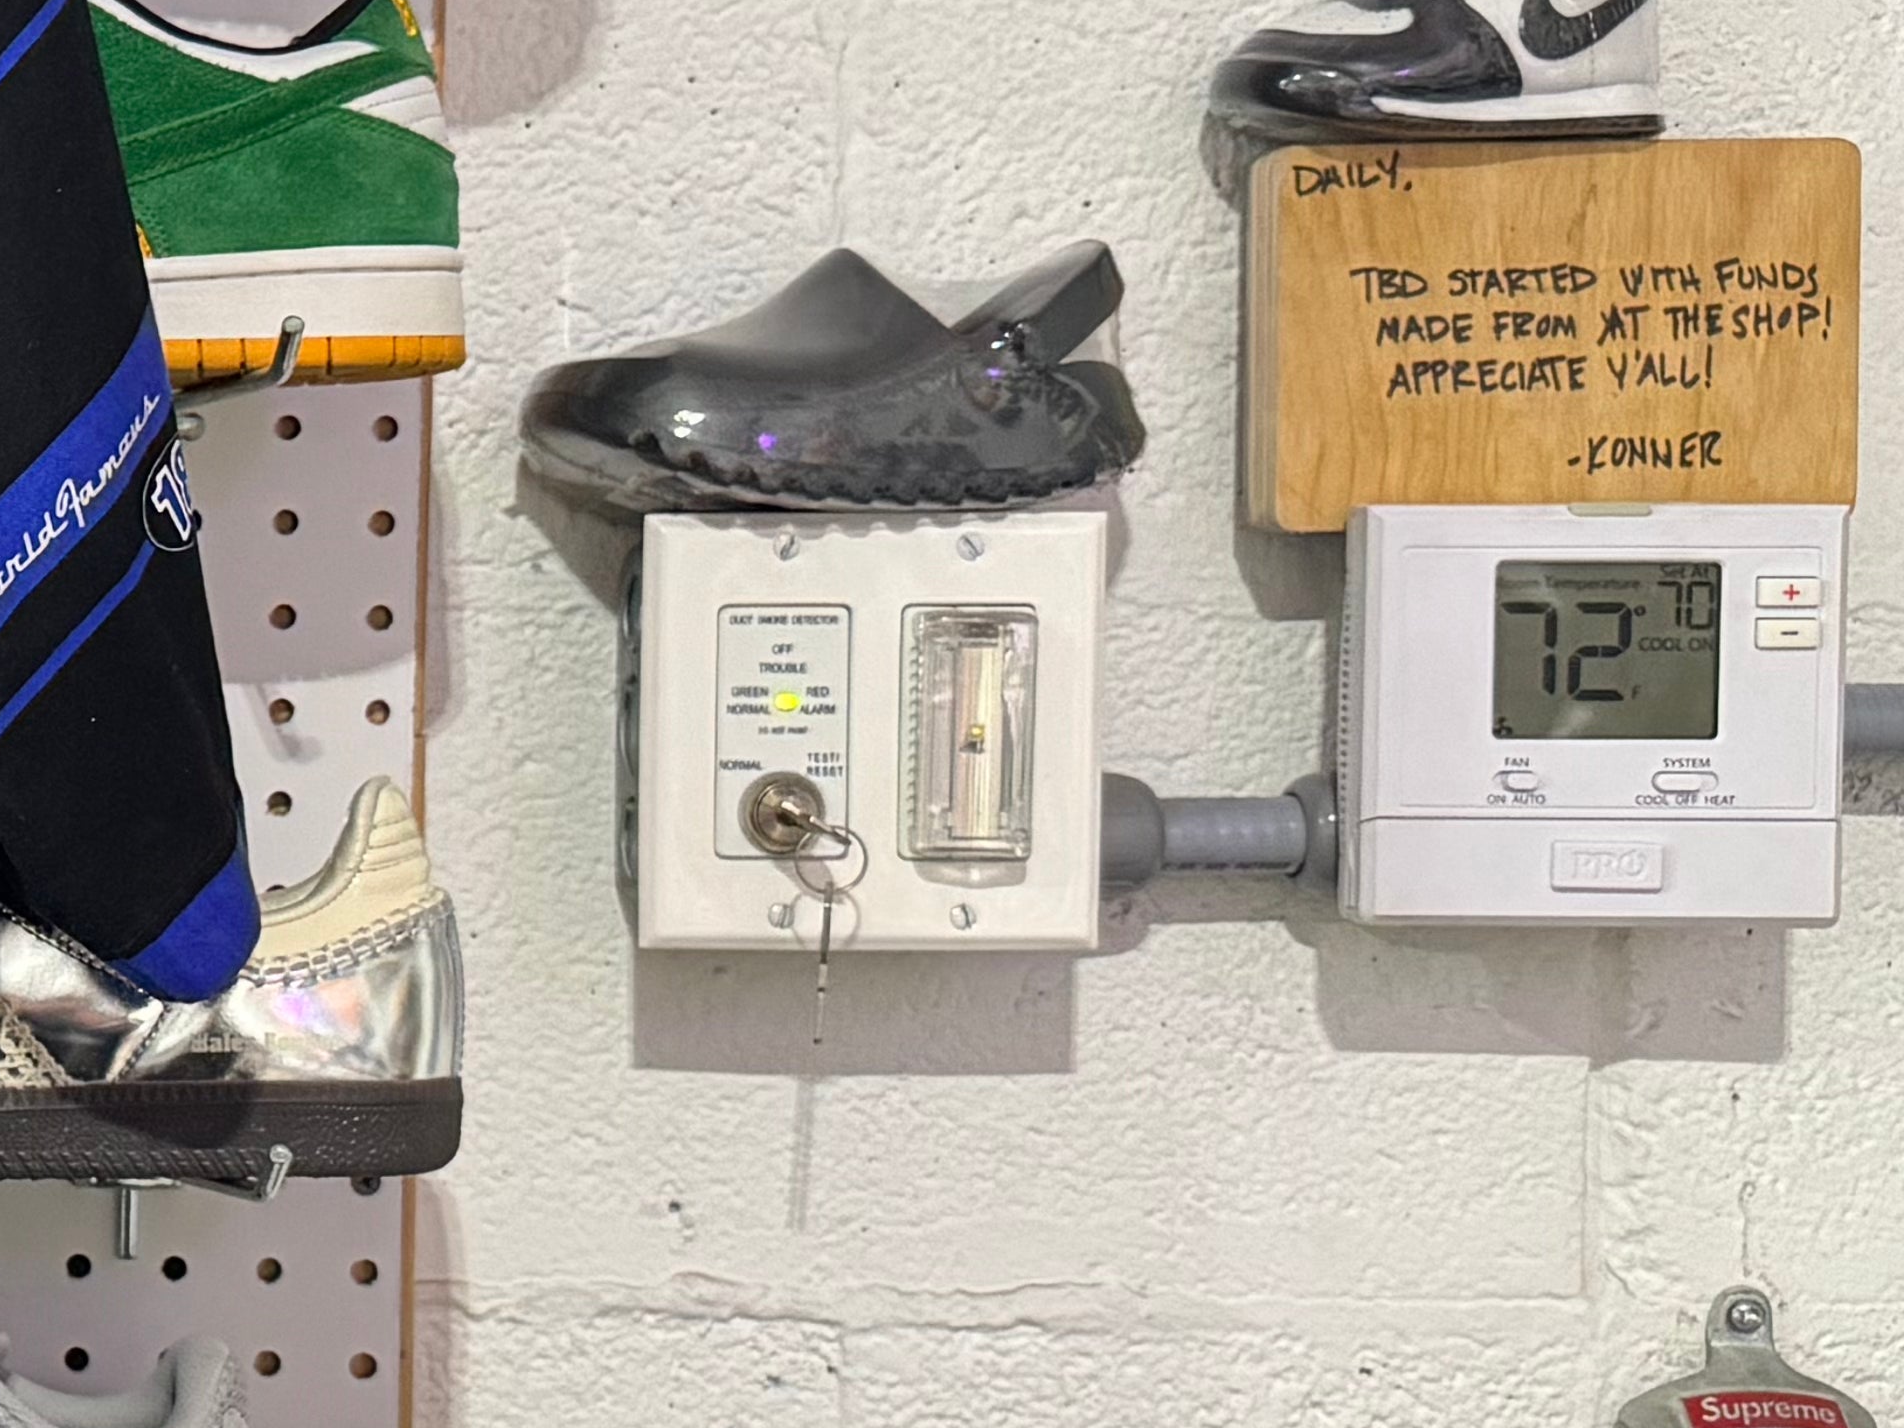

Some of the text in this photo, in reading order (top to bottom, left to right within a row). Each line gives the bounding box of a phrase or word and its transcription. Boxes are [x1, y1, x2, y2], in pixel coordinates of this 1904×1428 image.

[1447, 265, 1597, 296] STARTED
[1717, 257, 1818, 298] FUNDS
[1375, 313, 1473, 346] MADE
[1493, 310, 1578, 340] FROM
[1387, 355, 1586, 398] APPRECIATE
[1657, 580, 1714, 630] 70
[806, 687, 829, 697] RED
[1505, 758, 1711, 768] FAN SYSTEM
[1512, 795, 1546, 805] AUTO
[1635, 795, 1668, 806] COOL
[1705, 795, 1735, 806] HEAT
[1701, 1396, 1836, 1425] Supreme
